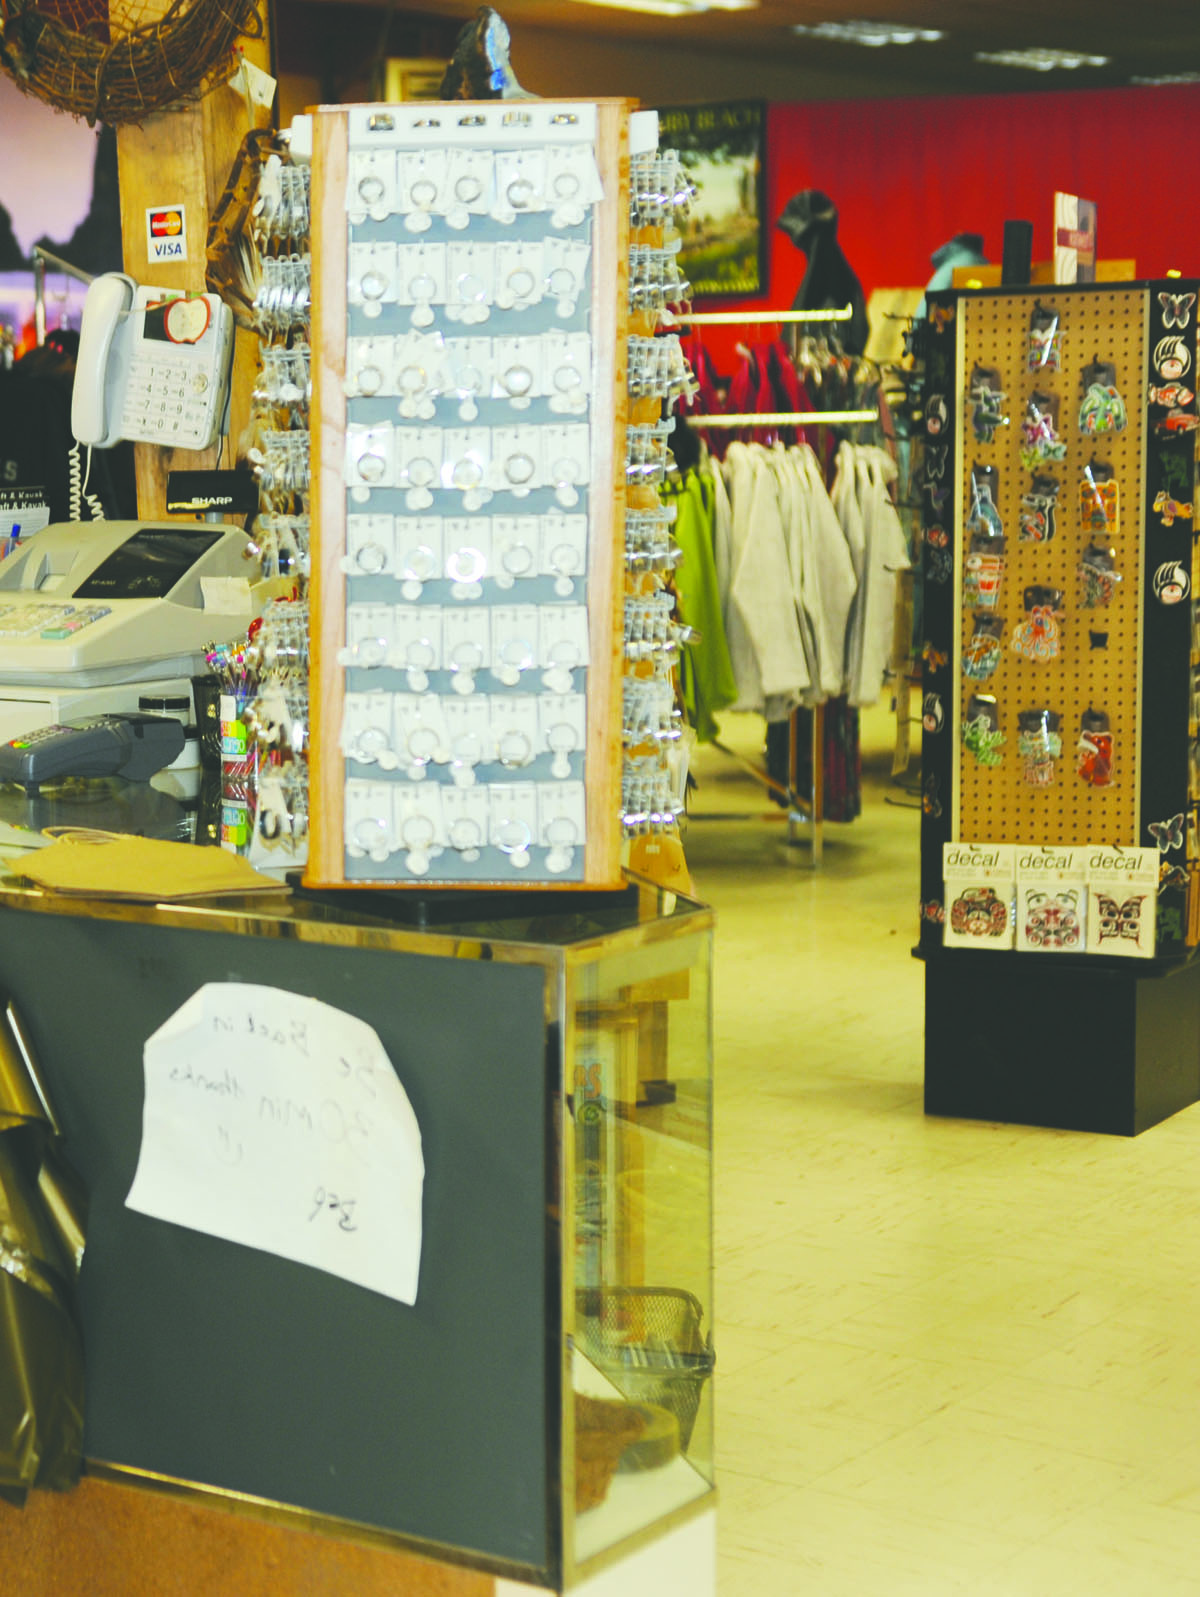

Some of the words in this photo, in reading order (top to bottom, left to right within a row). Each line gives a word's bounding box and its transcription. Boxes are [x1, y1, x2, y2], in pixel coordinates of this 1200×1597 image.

[154, 242, 183, 256] VISA
[12, 501, 19, 510] &
[191, 496, 233, 505] SHARP
[946, 850, 1000, 867] decal
[1019, 853, 1073, 870] decal
[1089, 853, 1143, 871] decal
